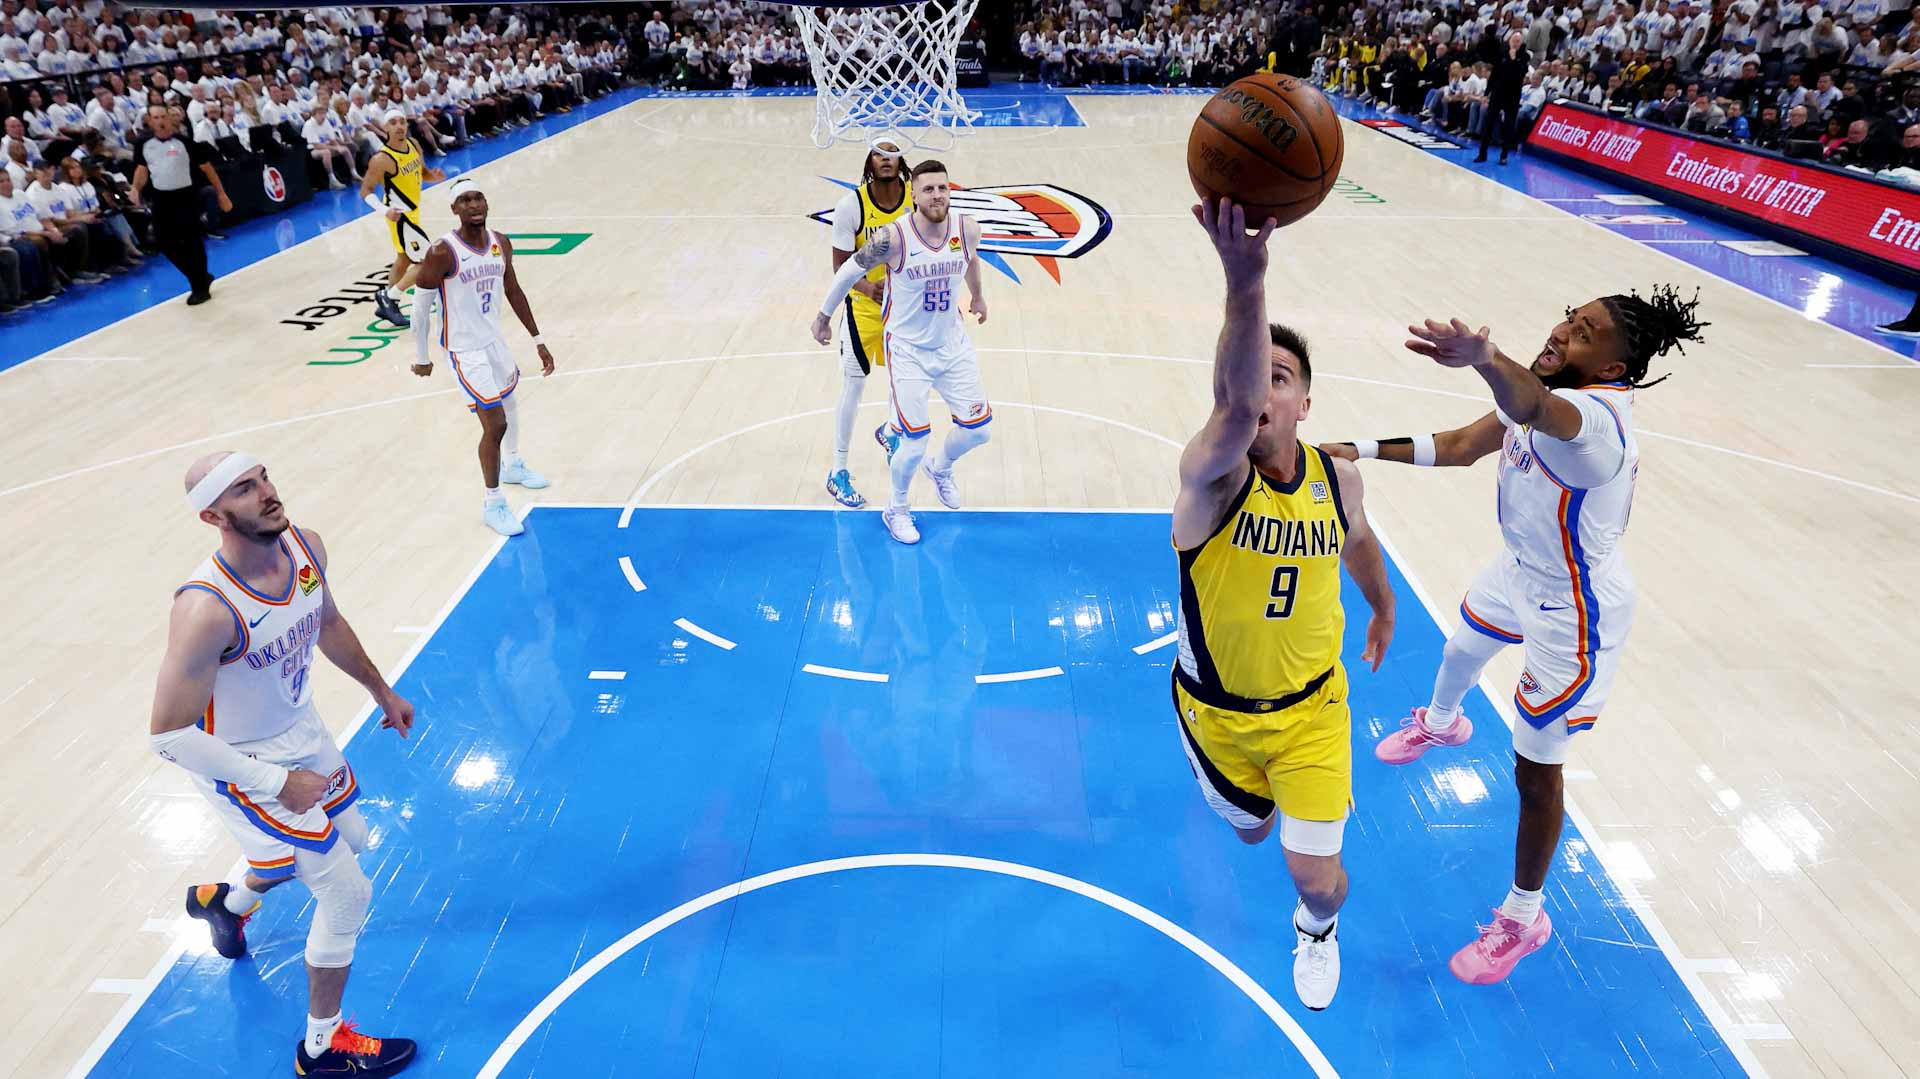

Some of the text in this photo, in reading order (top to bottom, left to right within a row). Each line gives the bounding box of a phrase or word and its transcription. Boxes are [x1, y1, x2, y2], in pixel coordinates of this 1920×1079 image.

[955, 57, 982, 70] Finals
[1537, 115, 1643, 163] Emirates FLY BETTER
[1666, 151, 1826, 218] Emirates FLY BETTER
[476, 278, 496, 293] CITY
[906, 260, 964, 281] OKLAHOMA
[925, 277, 951, 291] CITY
[481, 292, 492, 314] 2
[923, 290, 951, 312] 55
[1231, 509, 1341, 558] INDIANA
[1264, 564, 1301, 620] 9
[244, 607, 321, 671] OKLAHOM
[290, 664, 308, 706] 9
